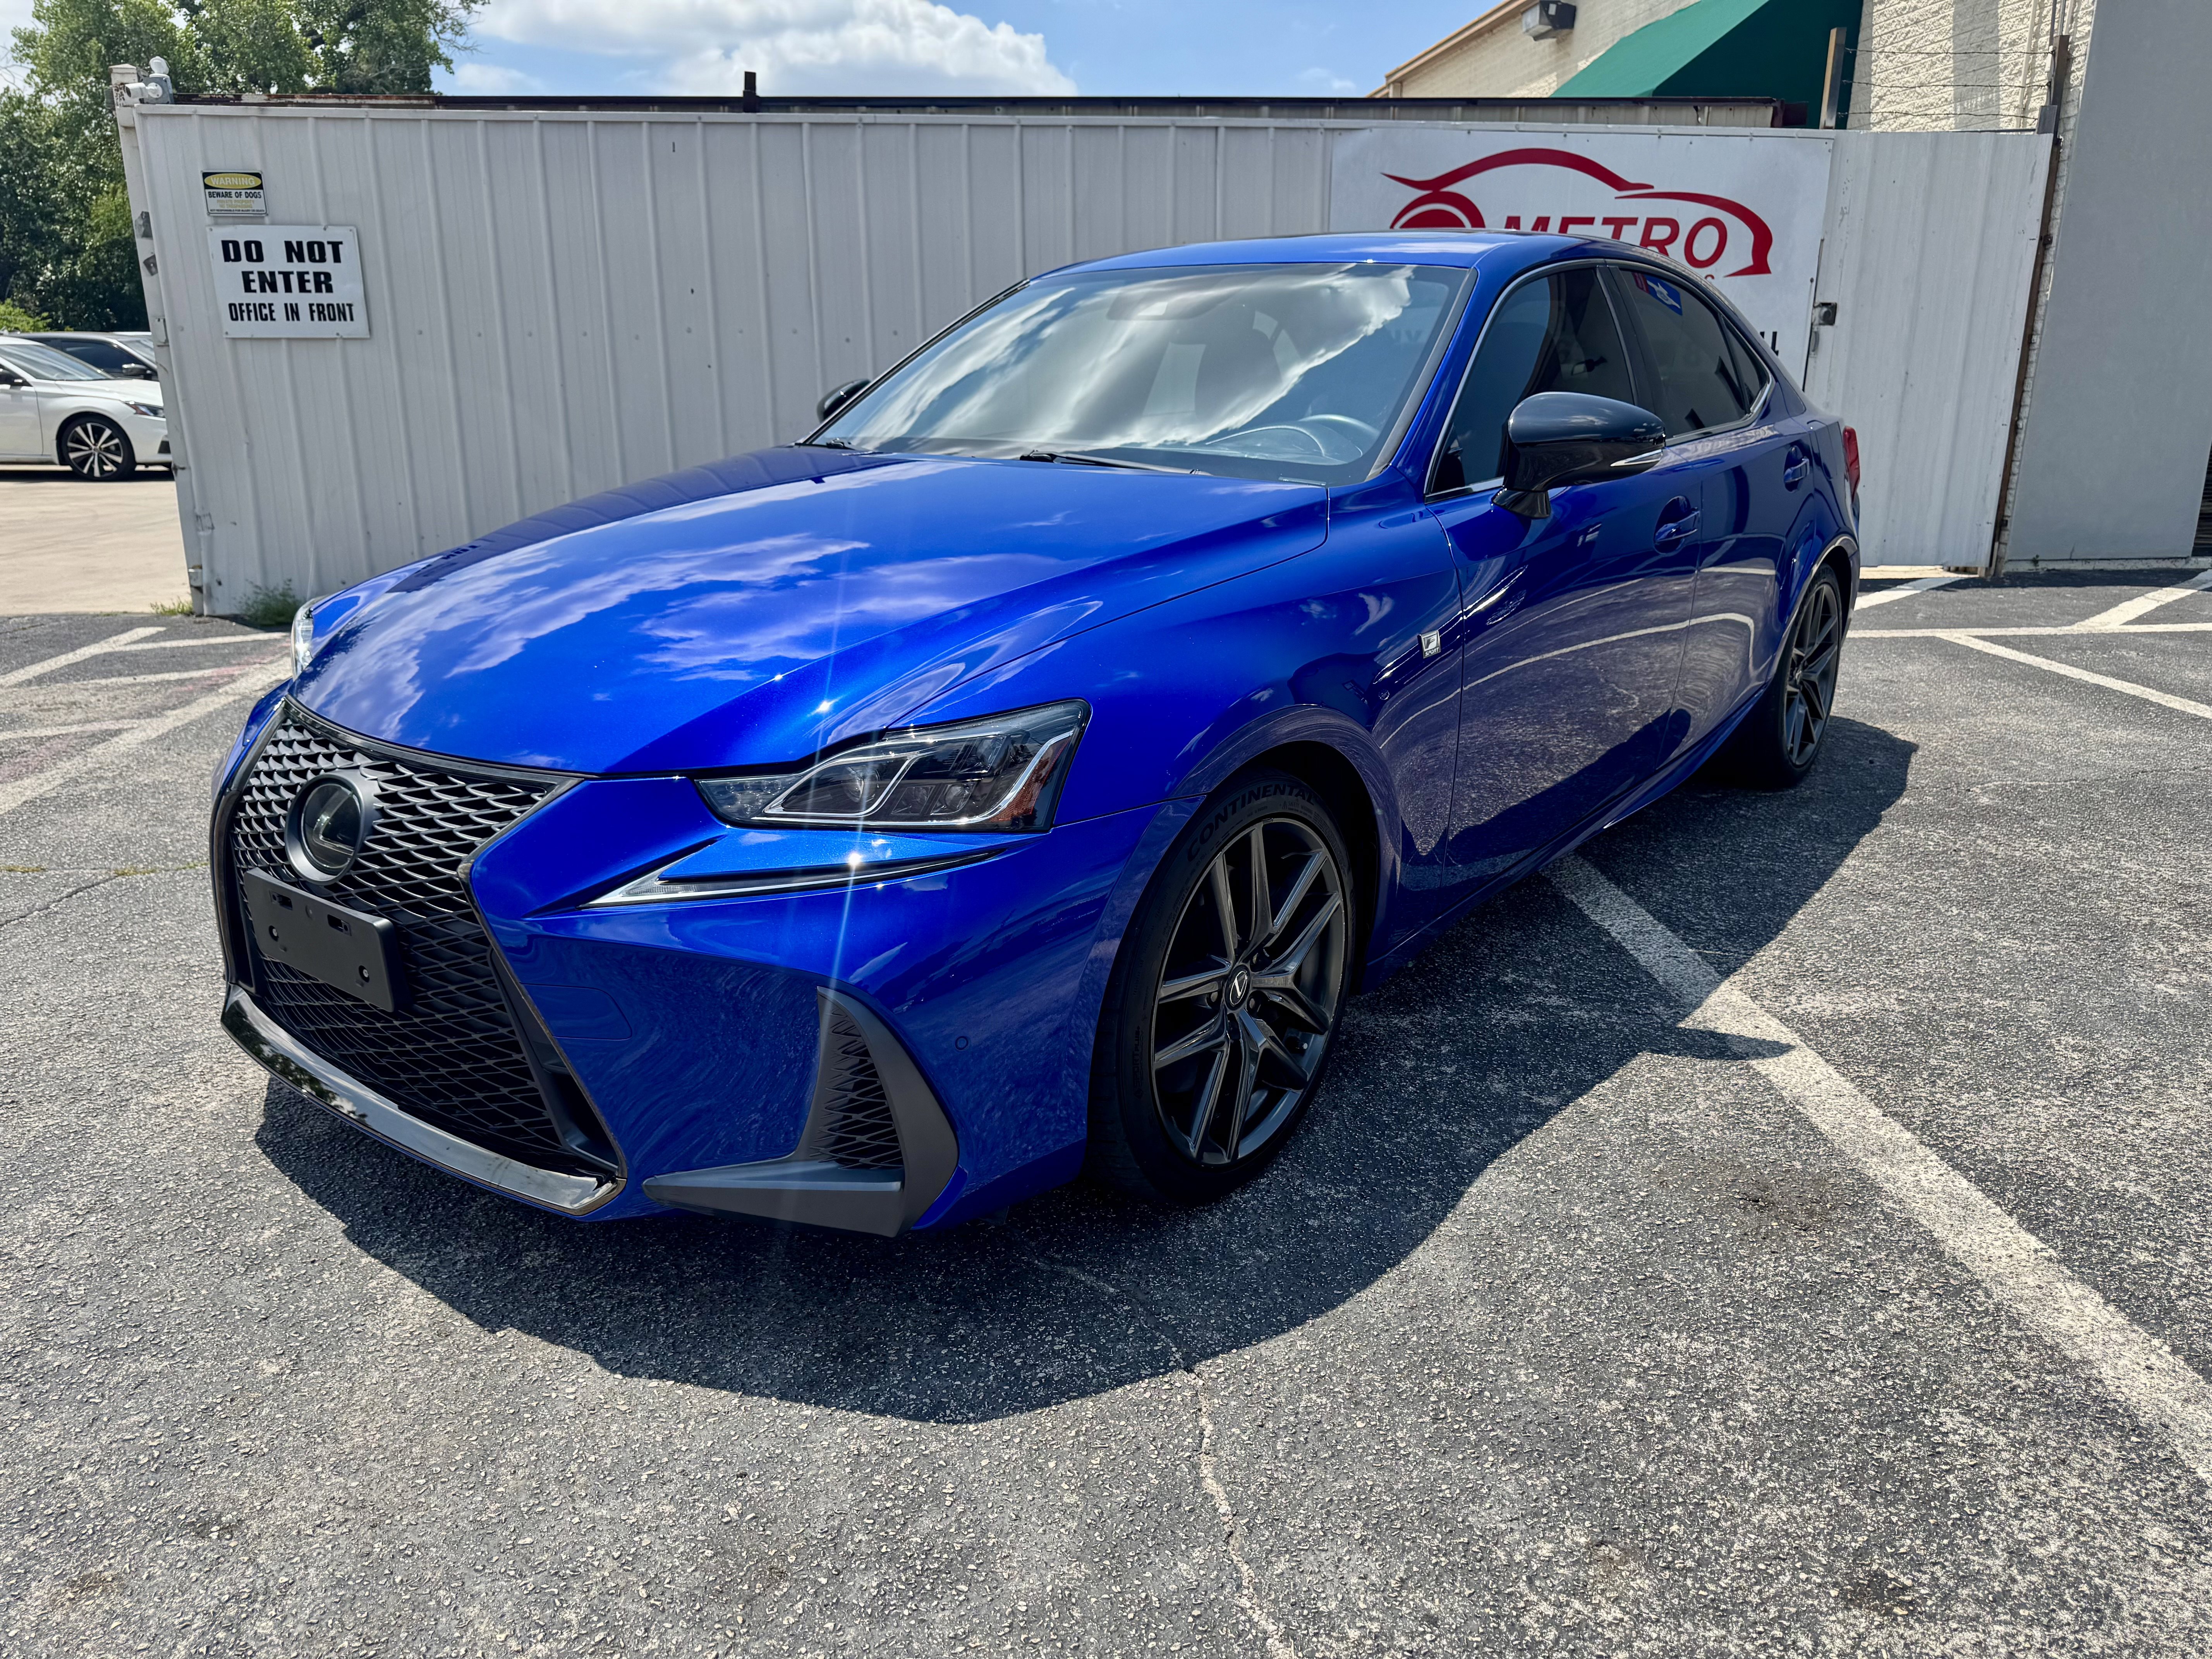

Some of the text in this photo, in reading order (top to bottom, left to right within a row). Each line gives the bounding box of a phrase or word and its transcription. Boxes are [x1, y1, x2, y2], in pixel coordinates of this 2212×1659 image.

[221, 240, 343, 263] DO NOT
[241, 271, 333, 293] ENTER
[228, 303, 354, 322] OFFICE IN FRONT
[1425, 647, 1439, 656] SPORT
[1187, 783, 1316, 862] CONTINENTAL
